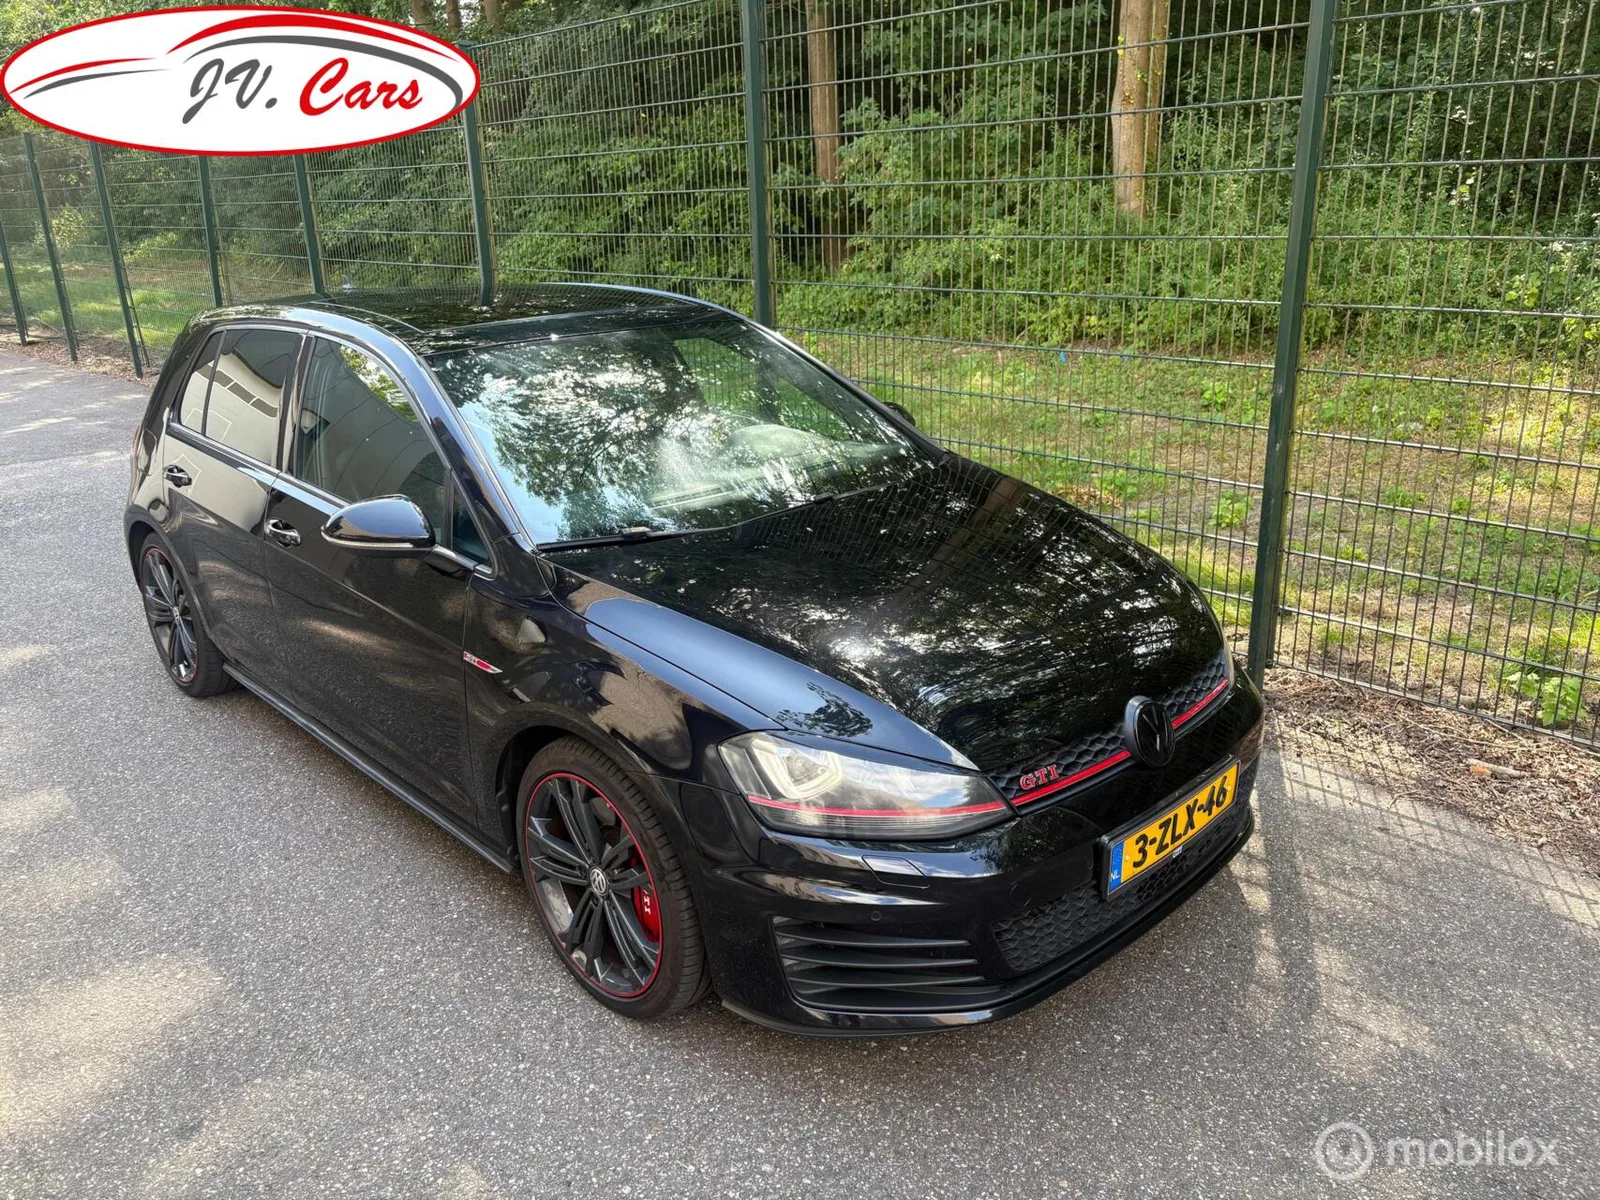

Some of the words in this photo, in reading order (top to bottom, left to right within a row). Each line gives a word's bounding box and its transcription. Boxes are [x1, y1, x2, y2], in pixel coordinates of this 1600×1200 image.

[1019, 764, 1059, 791] GTI
[1132, 775, 1228, 869] 3-ZLX-46
[1110, 869, 1121, 881] NL
